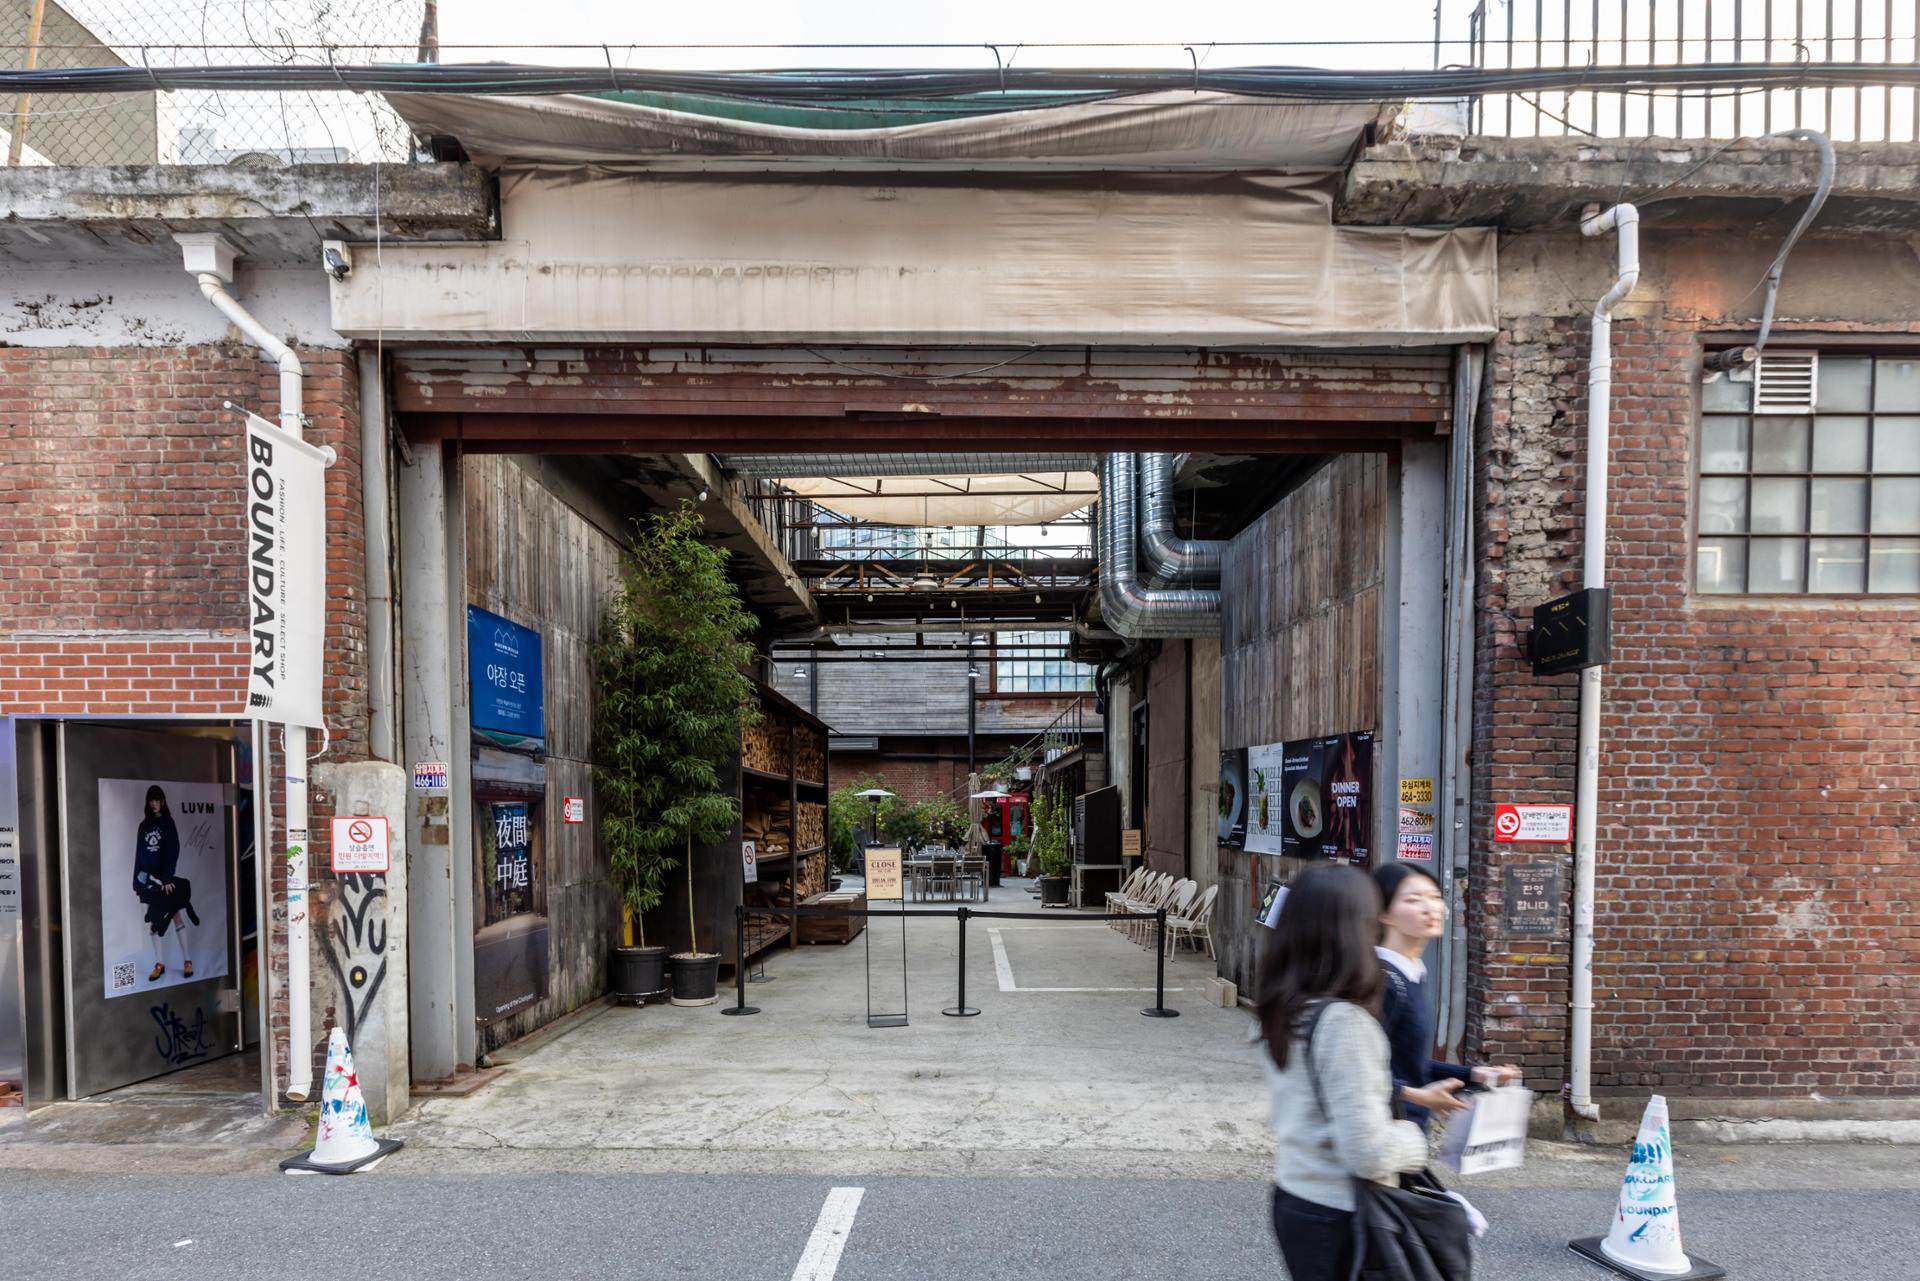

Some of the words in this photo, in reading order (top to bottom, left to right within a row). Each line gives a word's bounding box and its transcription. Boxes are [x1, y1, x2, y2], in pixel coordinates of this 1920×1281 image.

[250, 433, 275, 689] BOUNDARY
[279, 612, 287, 651] SELECT
[487, 664, 508, 688] 야장
[510, 671, 526, 693] 오픈
[415, 774, 448, 788] 466-1118
[1331, 781, 1360, 794] DINNER
[1337, 796, 1357, 808] OPEN
[1401, 791, 1432, 802] 464-3330
[181, 802, 215, 814] LUVM
[496, 815, 527, 849] 夜間
[497, 856, 528, 890] 中庭
[1516, 900, 1548, 911] 합니다
